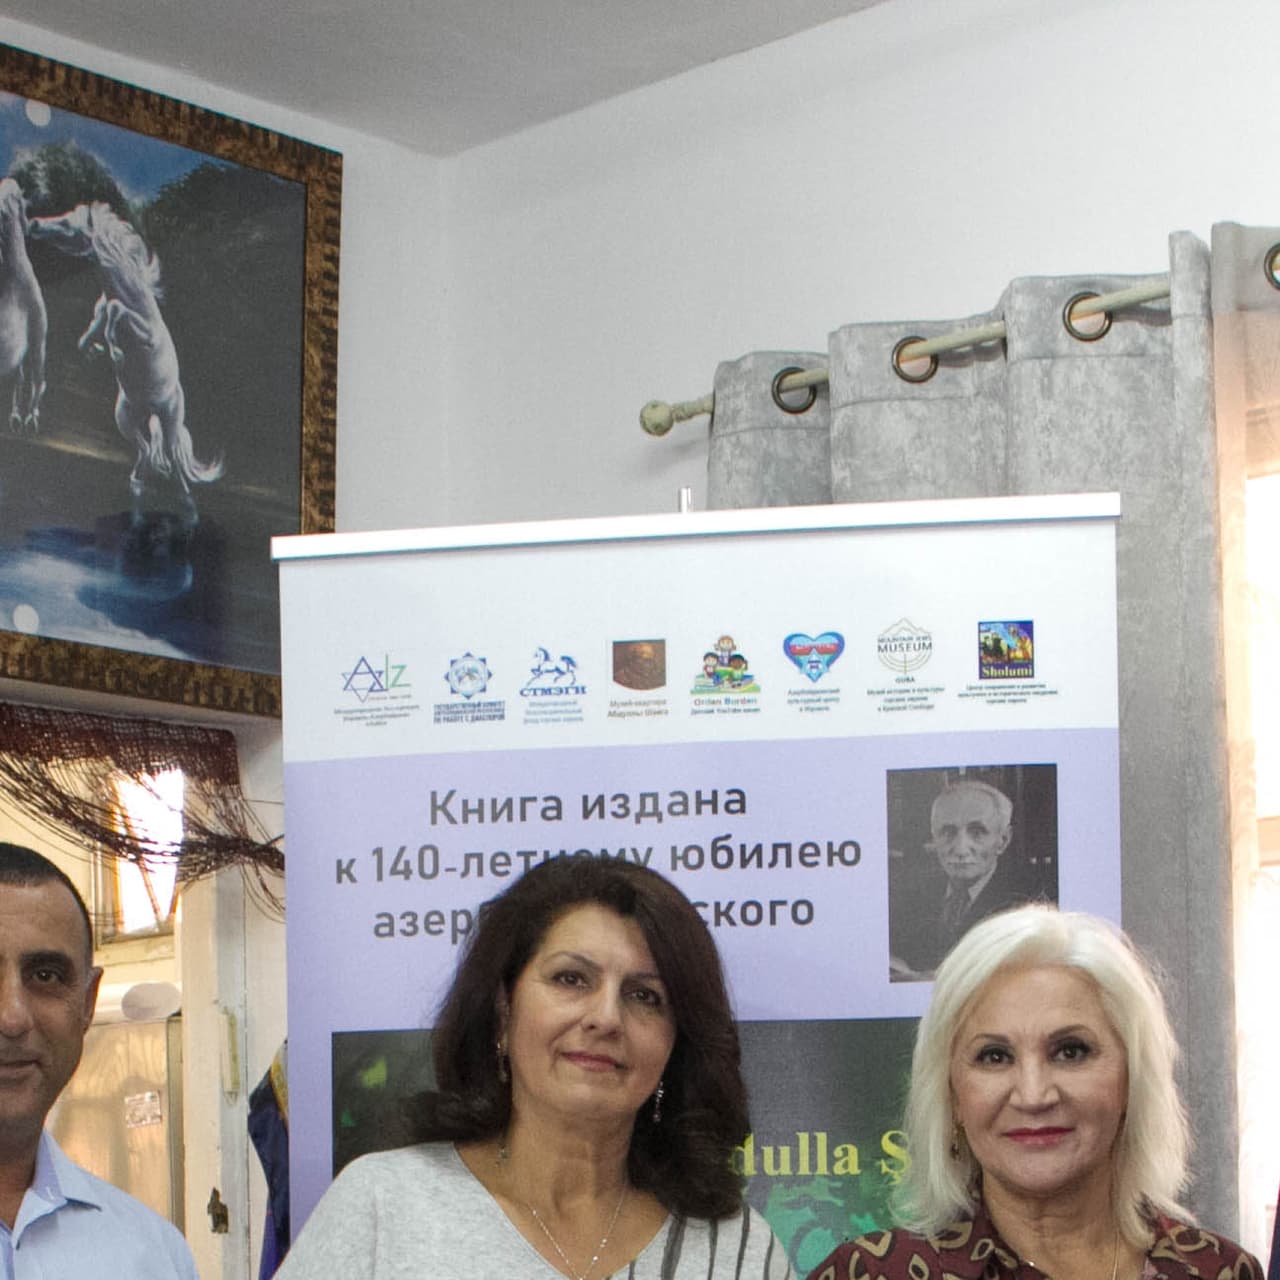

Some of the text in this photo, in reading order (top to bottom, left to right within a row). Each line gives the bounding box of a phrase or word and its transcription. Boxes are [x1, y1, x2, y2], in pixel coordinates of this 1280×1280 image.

[877, 641, 932, 653] MUSEUM
[982, 665, 1032, 677] Sholumi
[429, 788, 747, 825] Книга издана
[335, 858, 358, 884] к
[671, 833, 862, 871] юбилею
[728, 1131, 862, 1177] dulla
